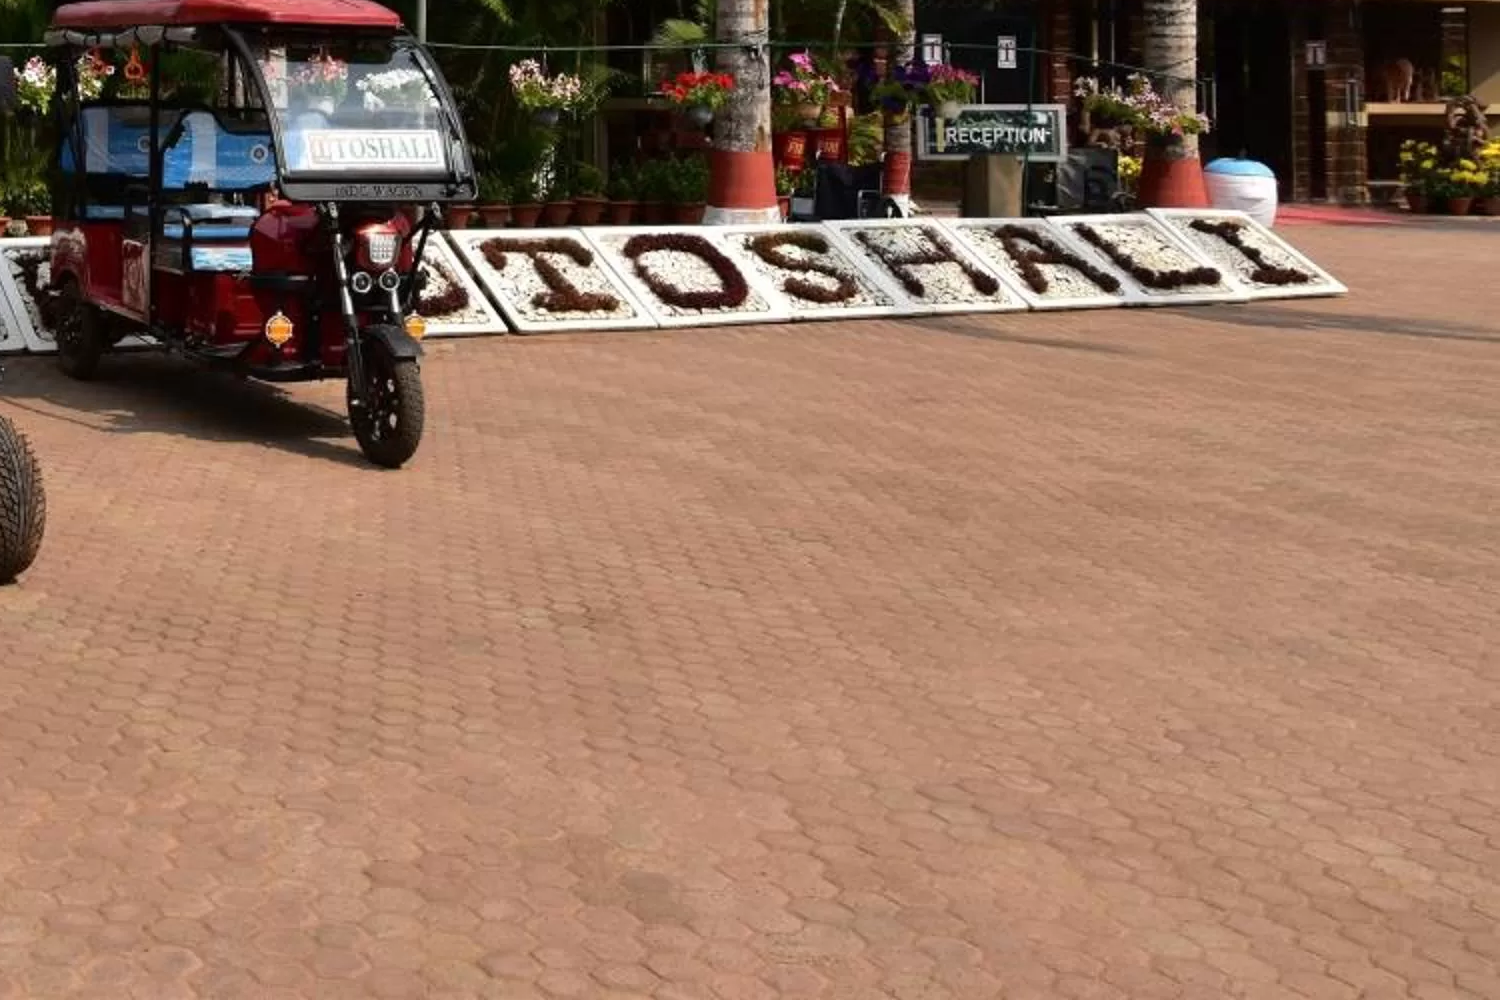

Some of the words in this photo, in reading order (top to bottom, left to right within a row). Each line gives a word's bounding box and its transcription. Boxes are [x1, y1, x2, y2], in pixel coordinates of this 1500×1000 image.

[945, 126, 1046, 144] RECEPTION
[330, 137, 434, 159] TOSHALI
[480, 218, 1311, 312] TOSHALI
